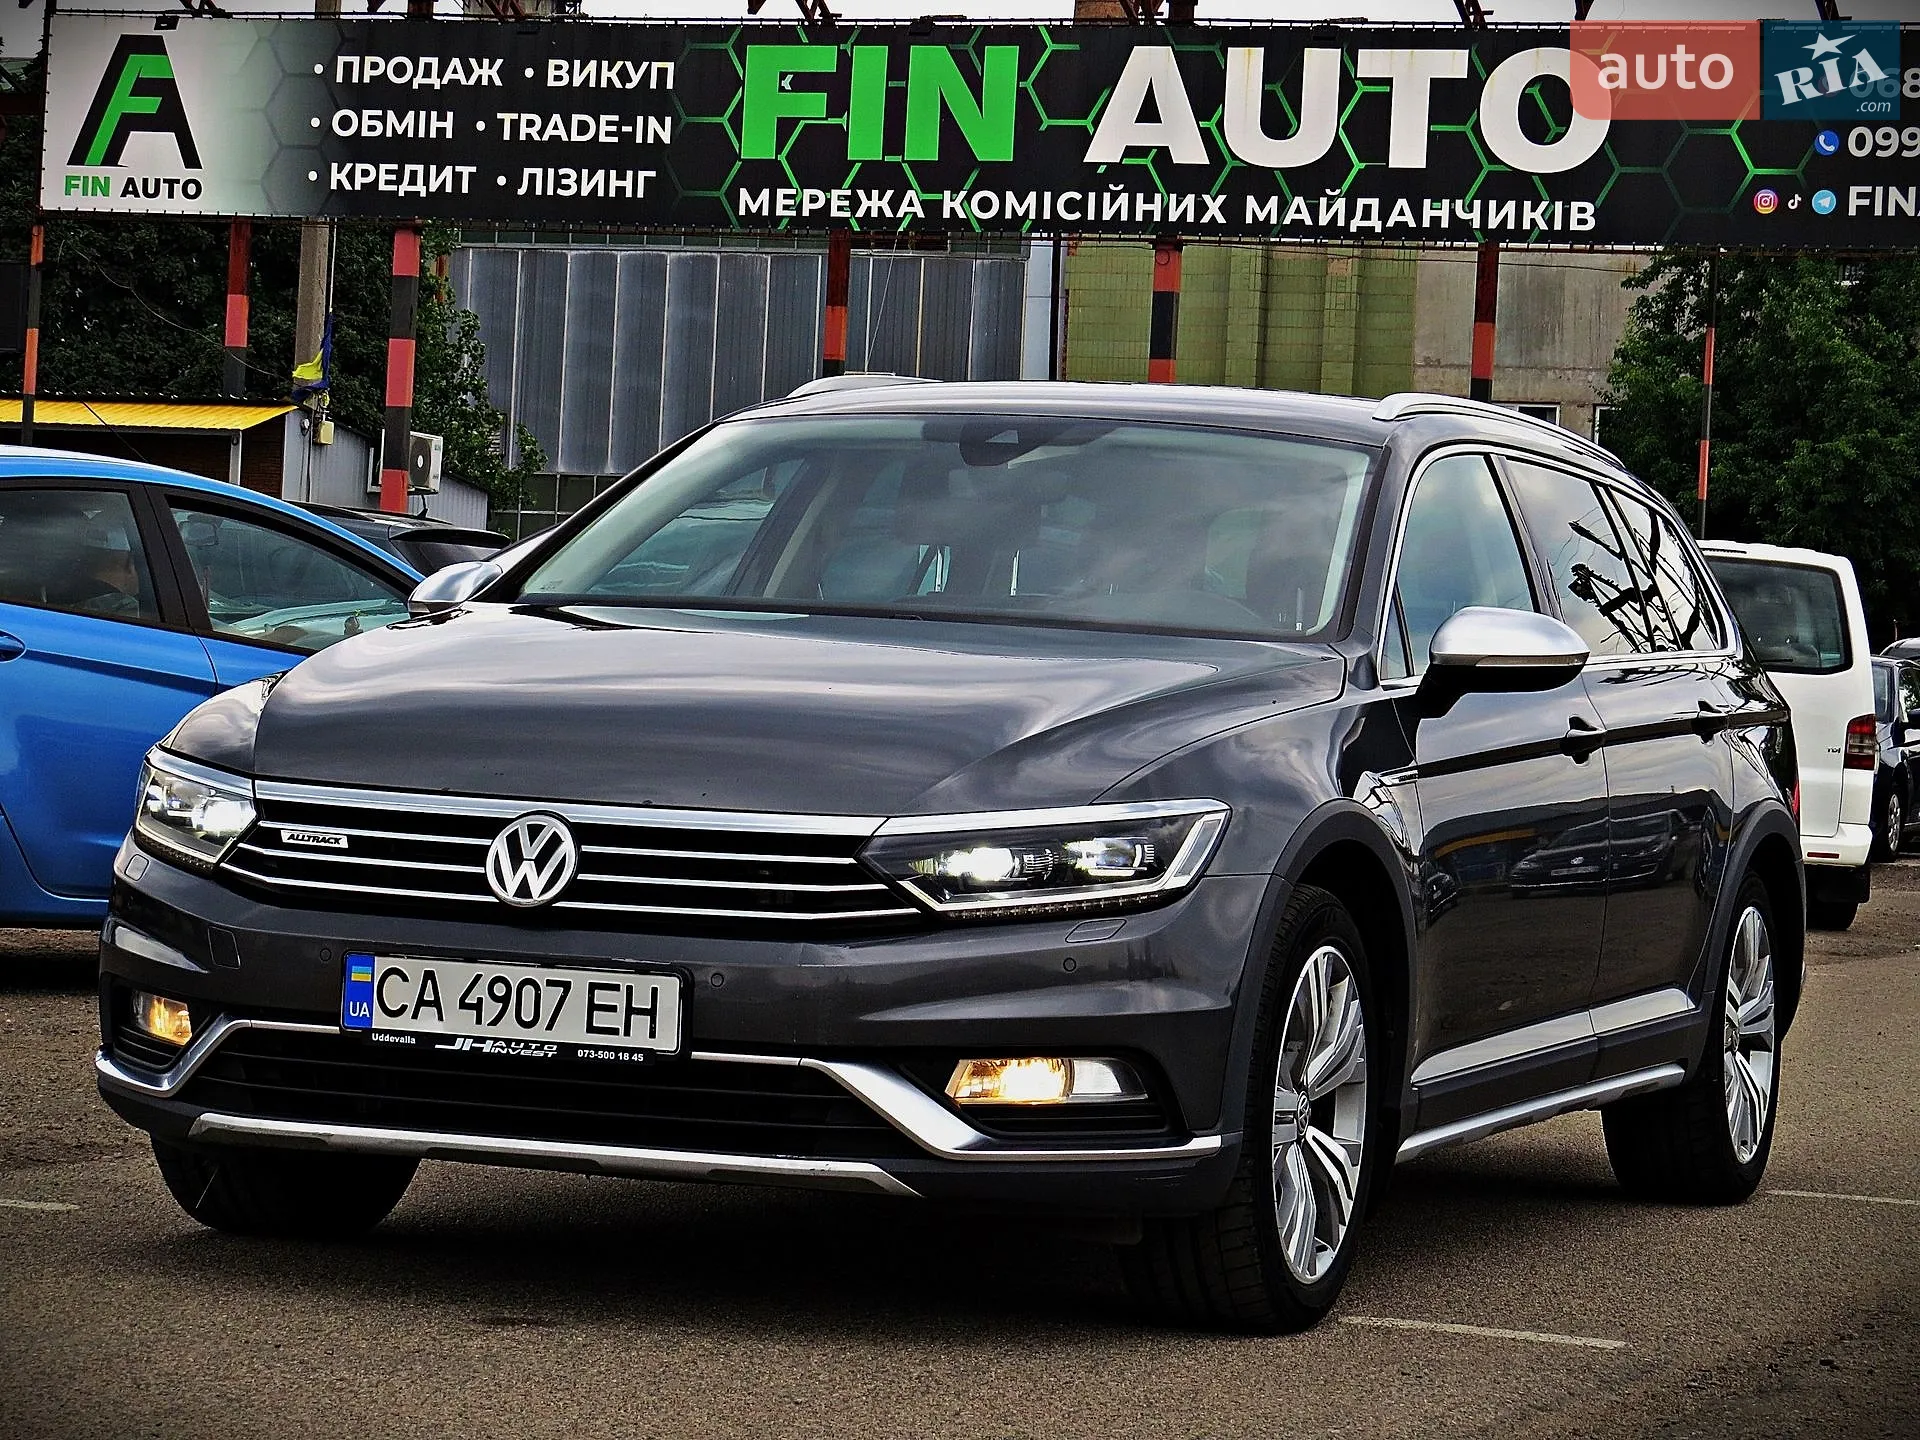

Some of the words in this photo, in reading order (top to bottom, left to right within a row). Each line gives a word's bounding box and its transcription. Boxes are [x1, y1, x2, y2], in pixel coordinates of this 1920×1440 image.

[335, 55, 503, 90] ПРОДАЖ
[546, 59, 675, 90] ВИКУП
[740, 45, 1020, 161] FIN
[1083, 46, 1612, 174] AUTO
[331, 109, 454, 139] ОБМІН
[496, 112, 673, 145] TRADE-IN
[1847, 126, 1920, 158] 099
[65, 175, 110, 197] FIN
[120, 177, 202, 200] AUTO
[329, 162, 477, 199] КРЕДИТ
[515, 167, 658, 199] ЛІЗИНГ
[738, 187, 925, 220] МЕРЕЖА
[942, 184, 1228, 225] КОМІСІЙНИХ
[1245, 189, 1596, 234] МАЙДАНЧИКІВ
[1848, 185, 1920, 217] FIN
[286, 832, 343, 845] ALLTRACK
[350, 1001, 370, 1018] UA
[376, 966, 444, 1022] CA
[458, 973, 573, 1031] 4907
[586, 982, 659, 1039] EH
[371, 1032, 416, 1045] Uddevalla
[493, 1040, 558, 1051] AUTO
[577, 1049, 616, 1061] 073-500
[617, 1051, 630, 1061] 18
[632, 1053, 644, 1062] 45
